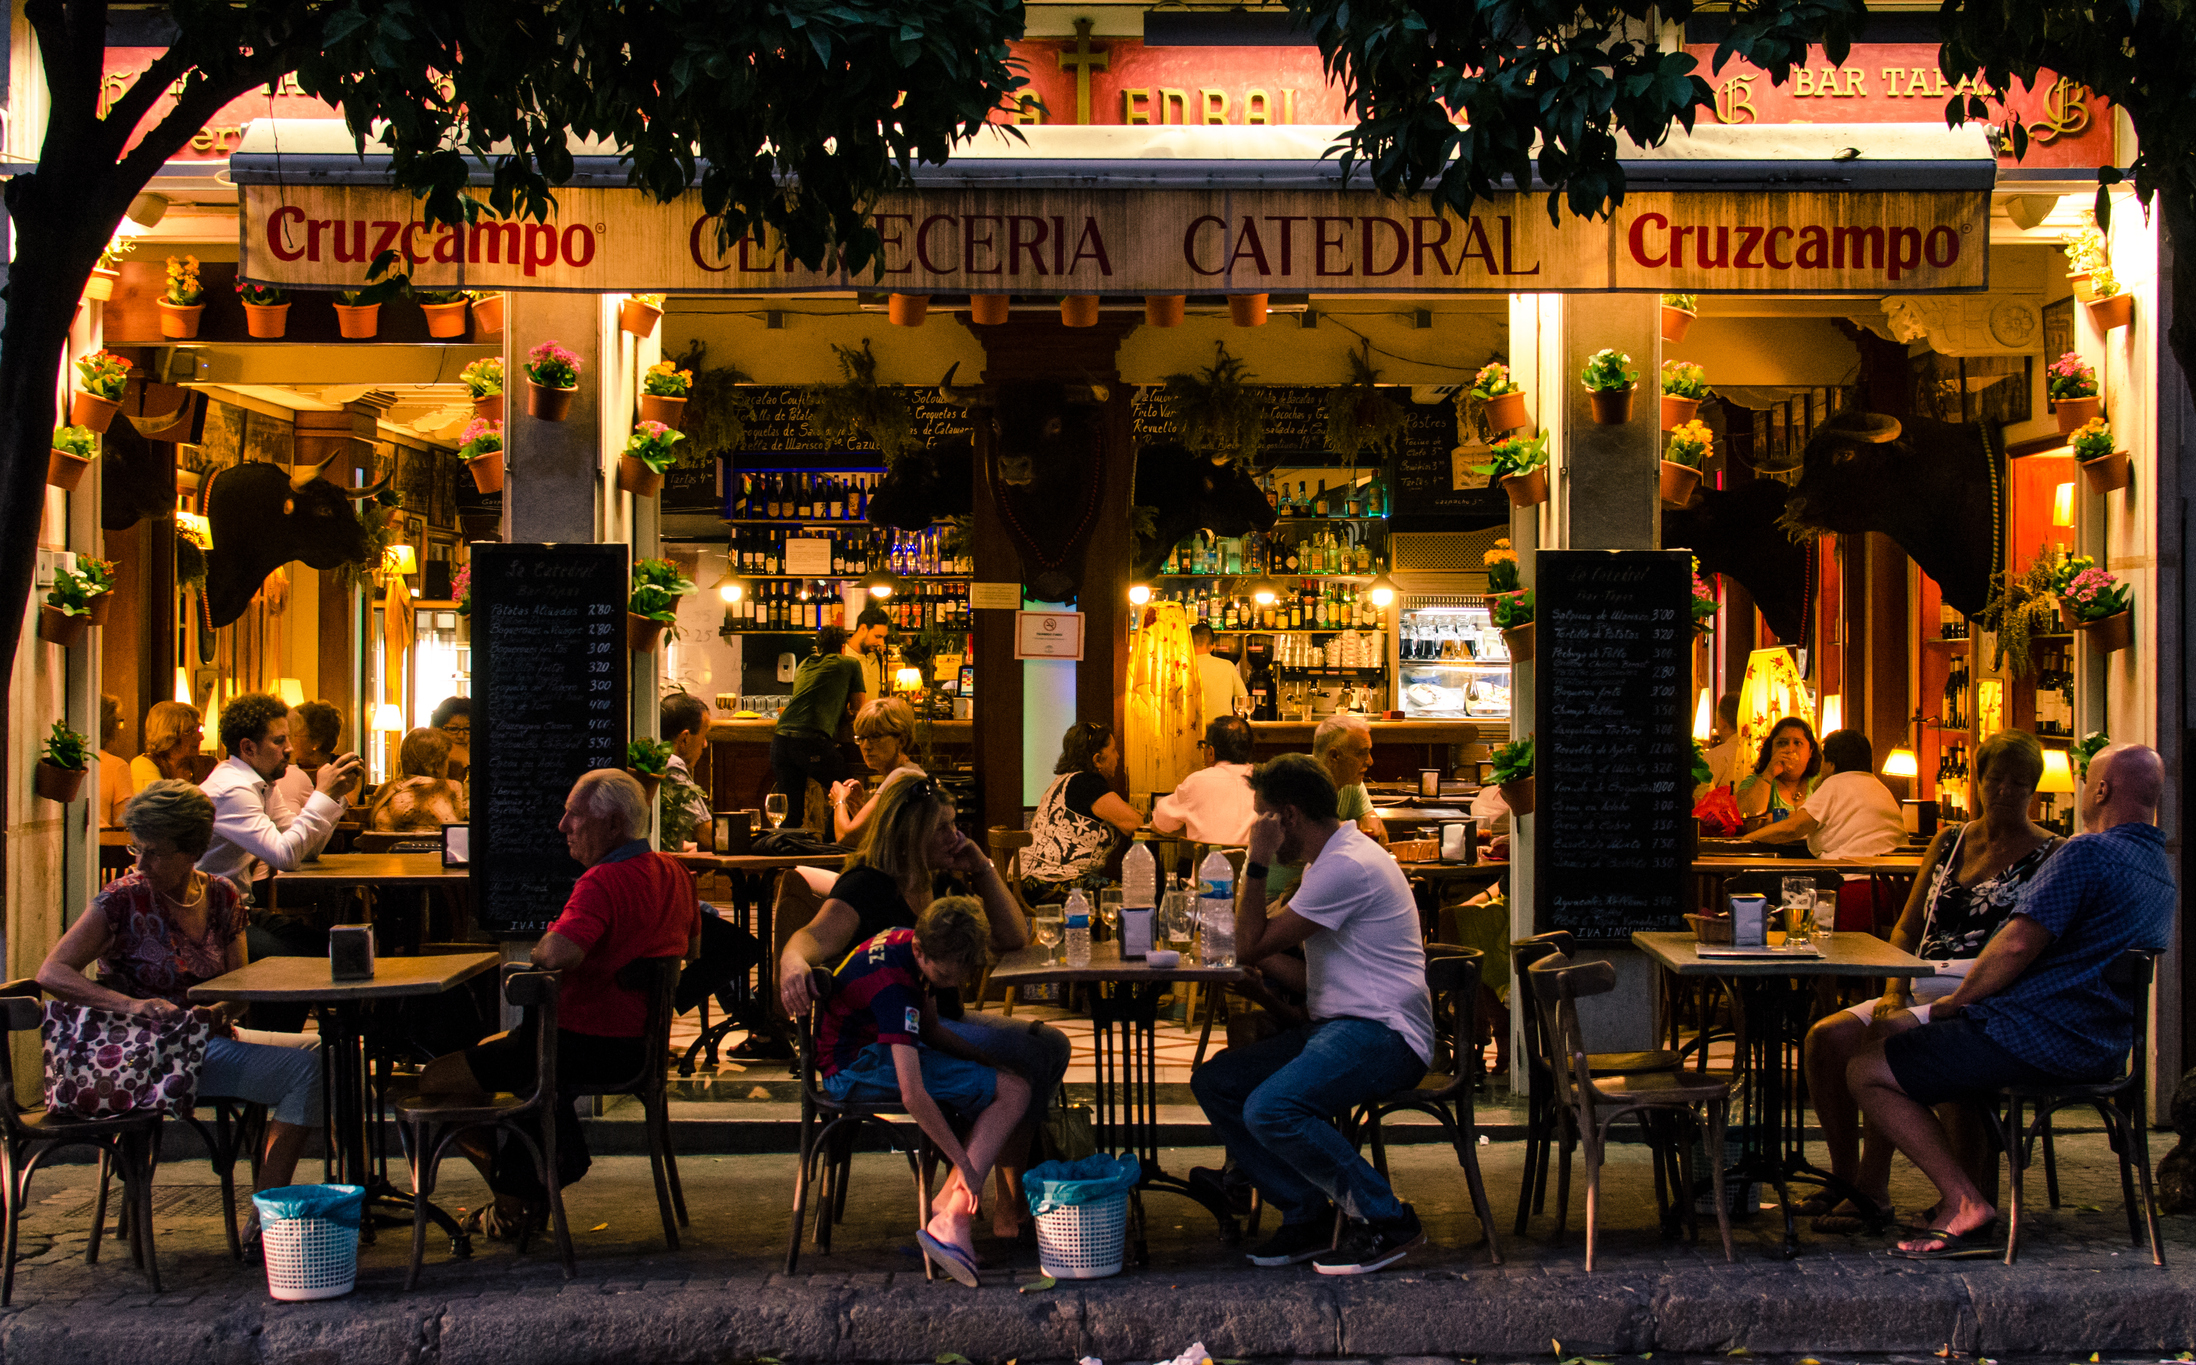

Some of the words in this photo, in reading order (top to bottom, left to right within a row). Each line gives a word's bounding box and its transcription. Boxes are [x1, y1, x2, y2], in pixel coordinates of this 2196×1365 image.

[1794, 67, 1868, 97] BAR
[1882, 67, 1996, 97] TAPA
[266, 205, 596, 277] Cruzcampo
[689, 213, 1113, 277] CEECERIA
[1184, 214, 1541, 277] CATEDRAL
[1628, 212, 1960, 282] Cruzcampo
[734, 408, 771, 421] Torlla
[1404, 412, 1447, 430] Postres
[746, 424, 780, 441] roquetas
[934, 422, 974, 435] Calamar
[669, 473, 697, 484] Tartas
[1577, 927, 1601, 937] IVA
